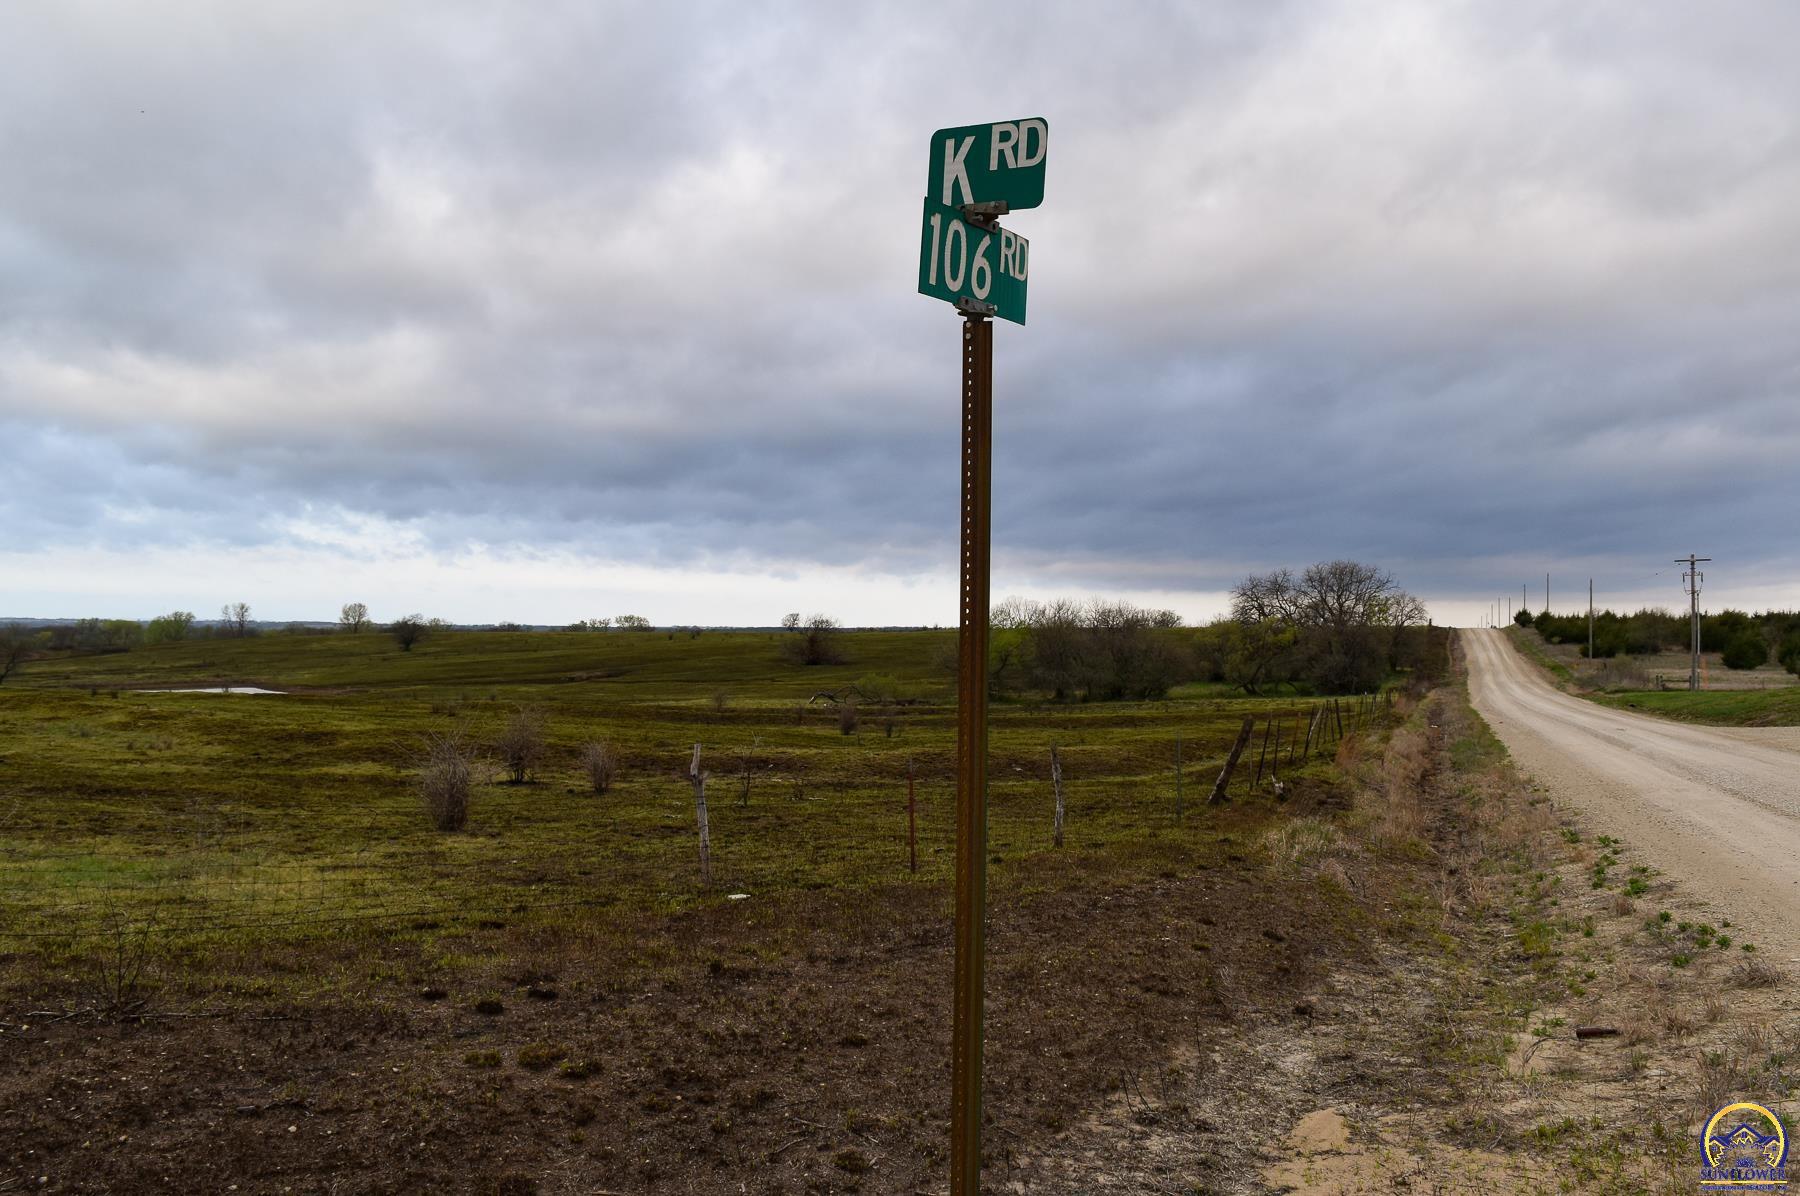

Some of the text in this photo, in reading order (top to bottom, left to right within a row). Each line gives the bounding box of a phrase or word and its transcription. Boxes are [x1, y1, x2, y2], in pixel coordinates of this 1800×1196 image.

[942, 119, 1047, 206] K RD
[928, 212, 1029, 300] 106 RD
